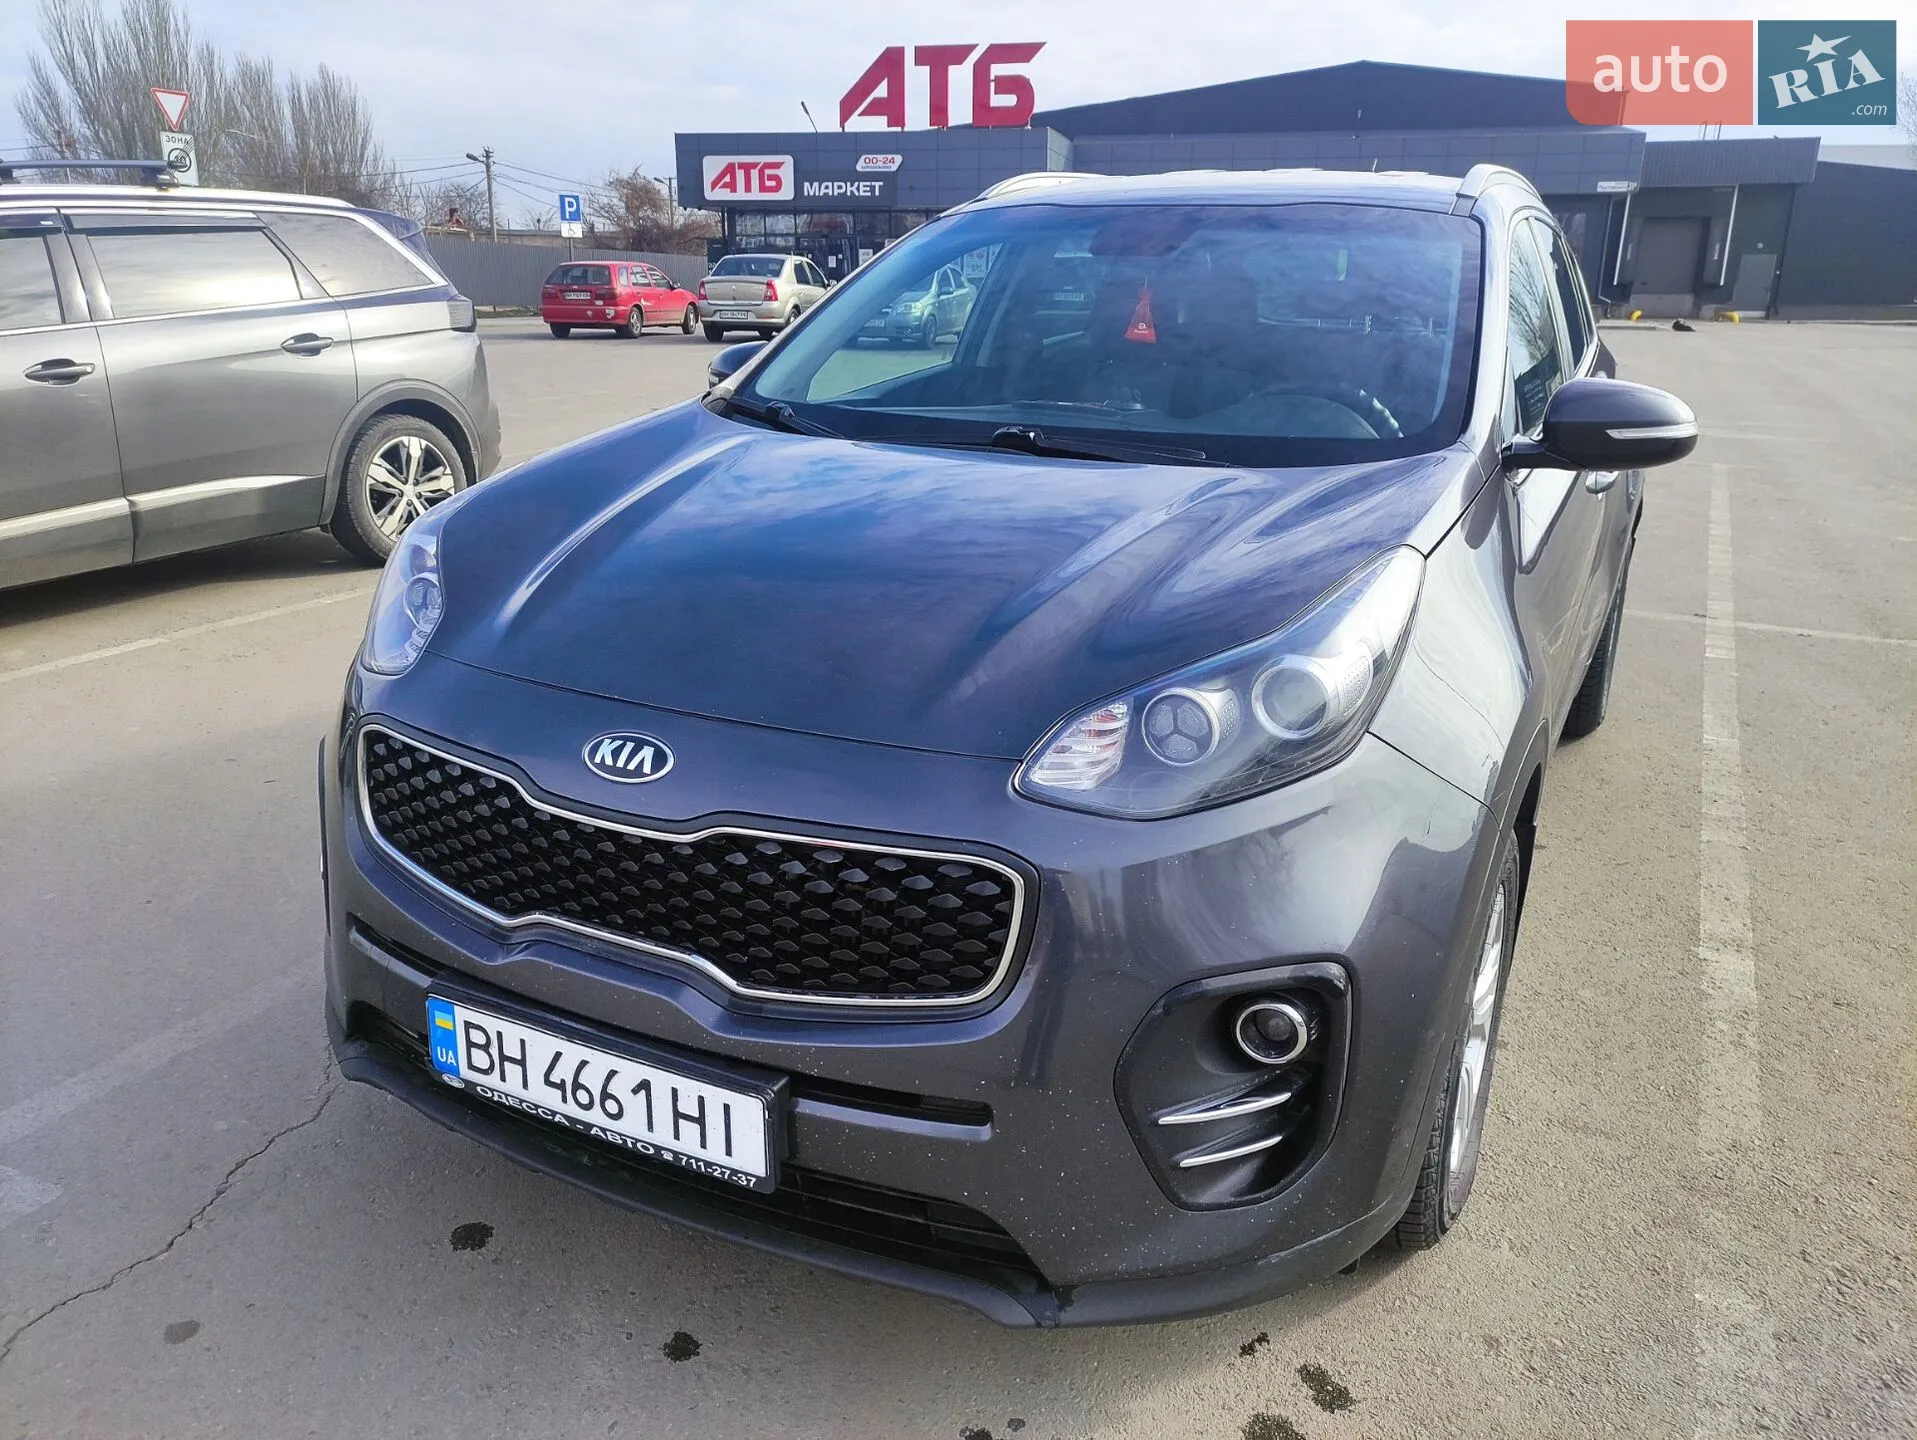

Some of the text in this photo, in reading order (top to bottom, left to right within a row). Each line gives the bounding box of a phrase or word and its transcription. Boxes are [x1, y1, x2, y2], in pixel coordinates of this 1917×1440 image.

[839, 42, 1047, 128] АТБ
[710, 161, 785, 194] АТБ
[804, 182, 883, 196] МАРКЕТ
[564, 197, 577, 219] P
[593, 738, 655, 774] KIA
[437, 1049, 457, 1067] UA
[543, 1050, 655, 1133] 4661
[476, 1086, 570, 1126] ОДЕССА
[590, 1125, 655, 1155] АВТО
[678, 1153, 757, 1188] 711-27-37
